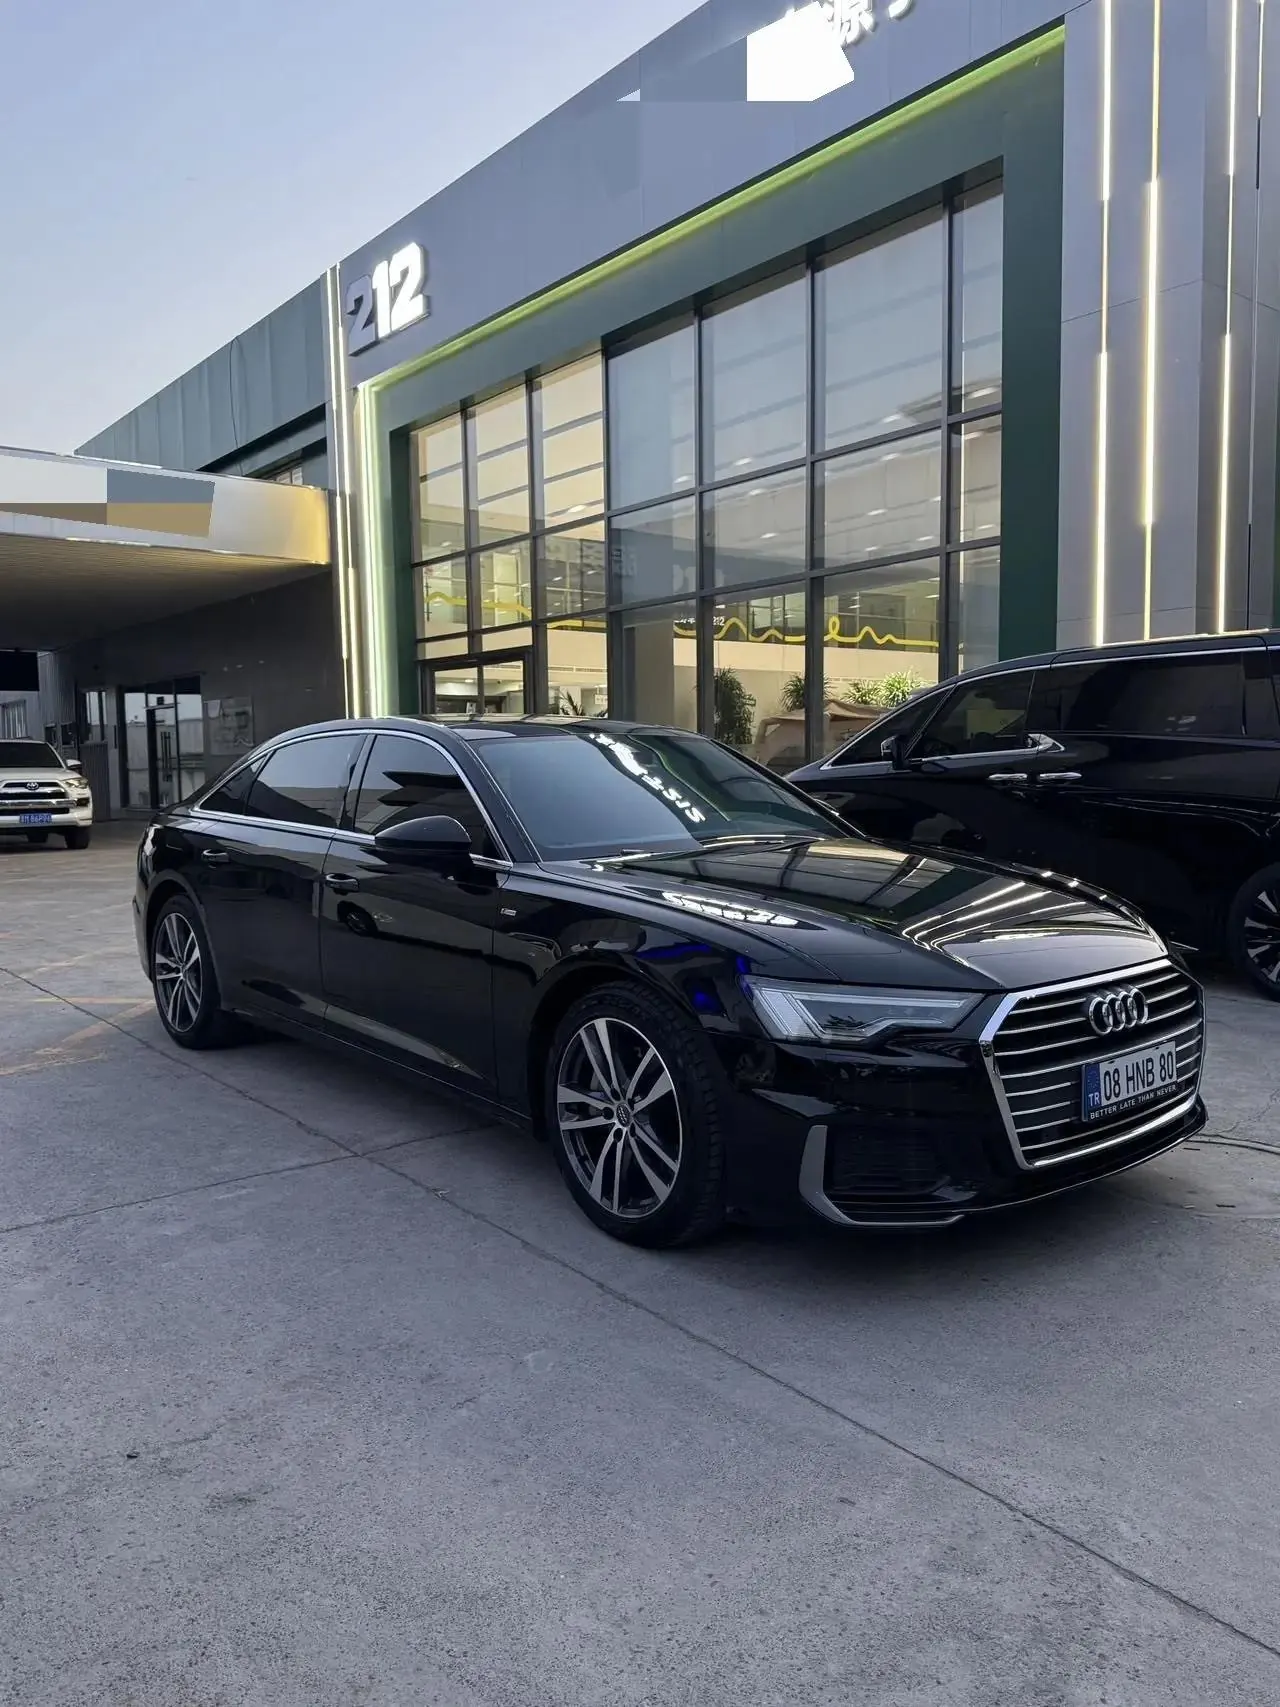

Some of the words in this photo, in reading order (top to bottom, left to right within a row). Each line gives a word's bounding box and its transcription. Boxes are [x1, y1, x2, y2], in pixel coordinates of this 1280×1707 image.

[345, 241, 426, 356] 212
[1103, 1067, 1121, 1101] 08
[1125, 1057, 1155, 1095] HNB
[1159, 1050, 1174, 1082] 80
[1088, 1092, 1100, 1107] TR
[1090, 1105, 1117, 1119] BETTER
[1120, 1099, 1136, 1110] LATE
[1138, 1092, 1154, 1102] THAN
[1156, 1085, 1177, 1096] NEVER
